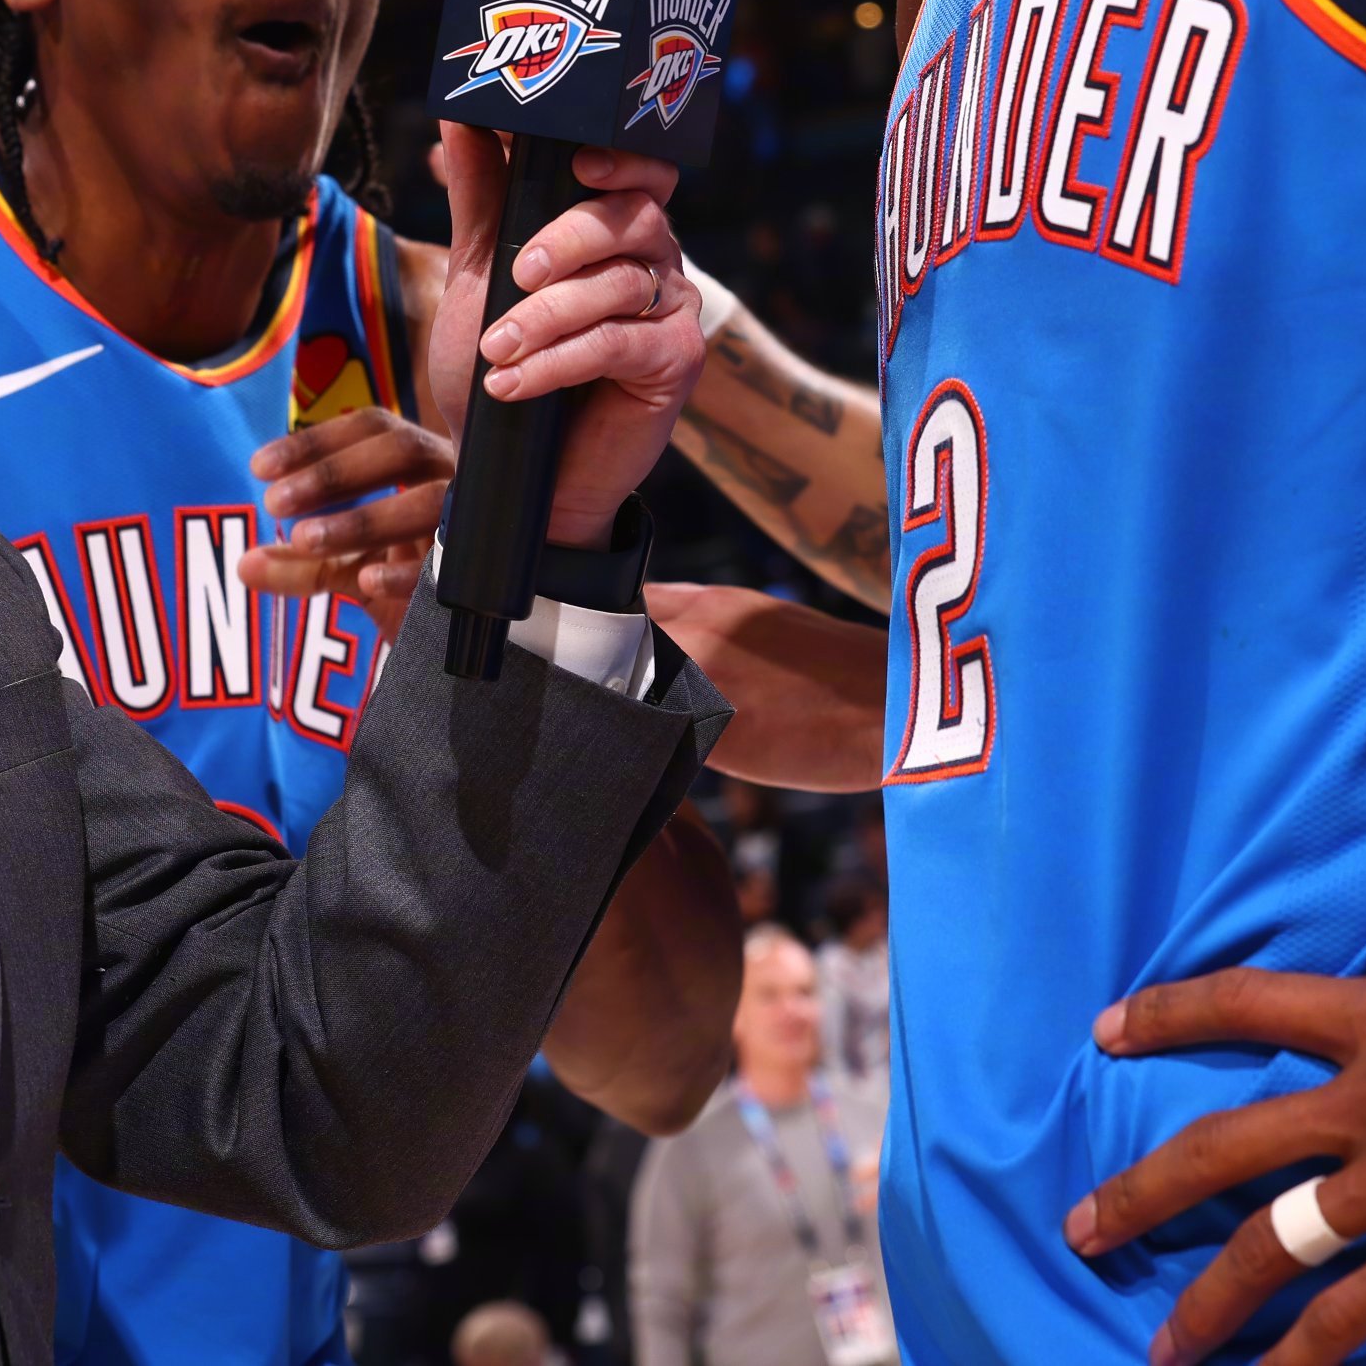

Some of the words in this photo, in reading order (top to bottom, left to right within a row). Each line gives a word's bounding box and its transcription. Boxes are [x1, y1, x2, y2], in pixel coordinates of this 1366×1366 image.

[471, 22, 566, 76] OKC
[641, 49, 695, 103] OKC
[882, 377, 996, 787] 2
